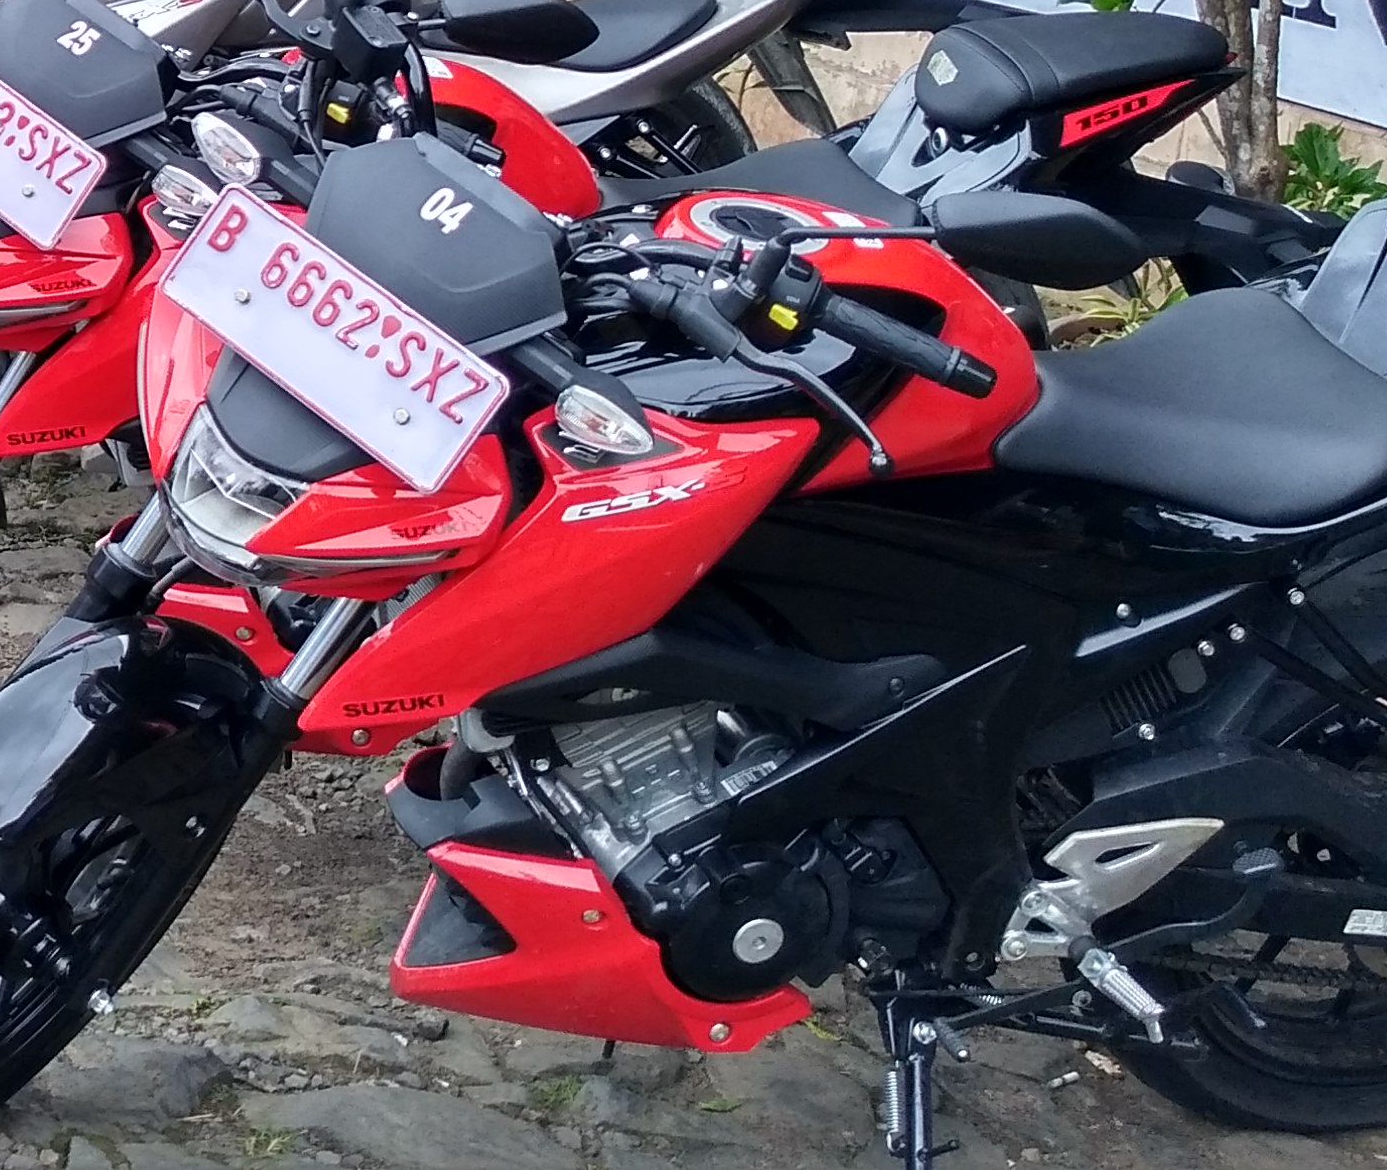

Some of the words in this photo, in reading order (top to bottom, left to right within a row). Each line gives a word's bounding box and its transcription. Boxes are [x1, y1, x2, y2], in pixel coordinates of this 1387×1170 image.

[56, 20, 102, 55] 25
[1075, 95, 1149, 131] 150
[18, 123, 93, 195] SXZ
[419, 187, 474, 235] 04
[30, 278, 95, 294] SUZUKI
[206, 203, 250, 252] B
[260, 242, 380, 351] 6662
[384, 330, 490, 425] SXZ
[6, 426, 87, 447] SUZUKI
[390, 518, 467, 540] SUZUKI
[342, 693, 446, 719] SUZUKI
